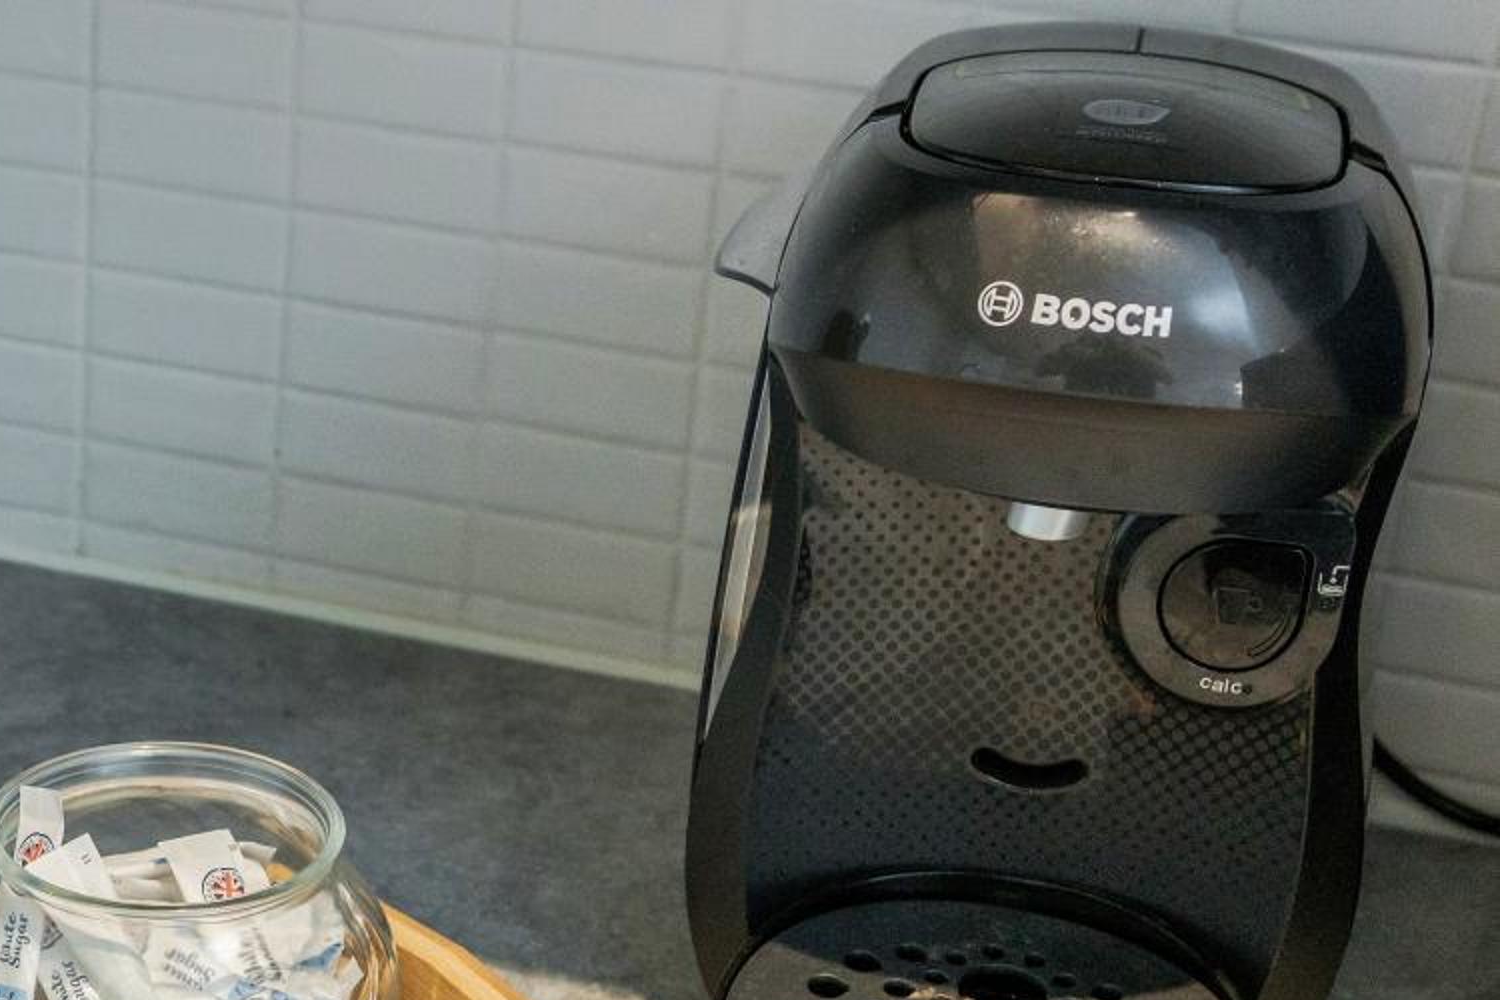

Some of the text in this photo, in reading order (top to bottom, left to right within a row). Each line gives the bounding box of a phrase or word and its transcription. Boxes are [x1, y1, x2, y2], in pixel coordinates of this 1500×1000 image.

[1031, 294, 1172, 338] BOSCH
[1199, 676, 1243, 695] calc
[9, 914, 31, 969] Sugar
